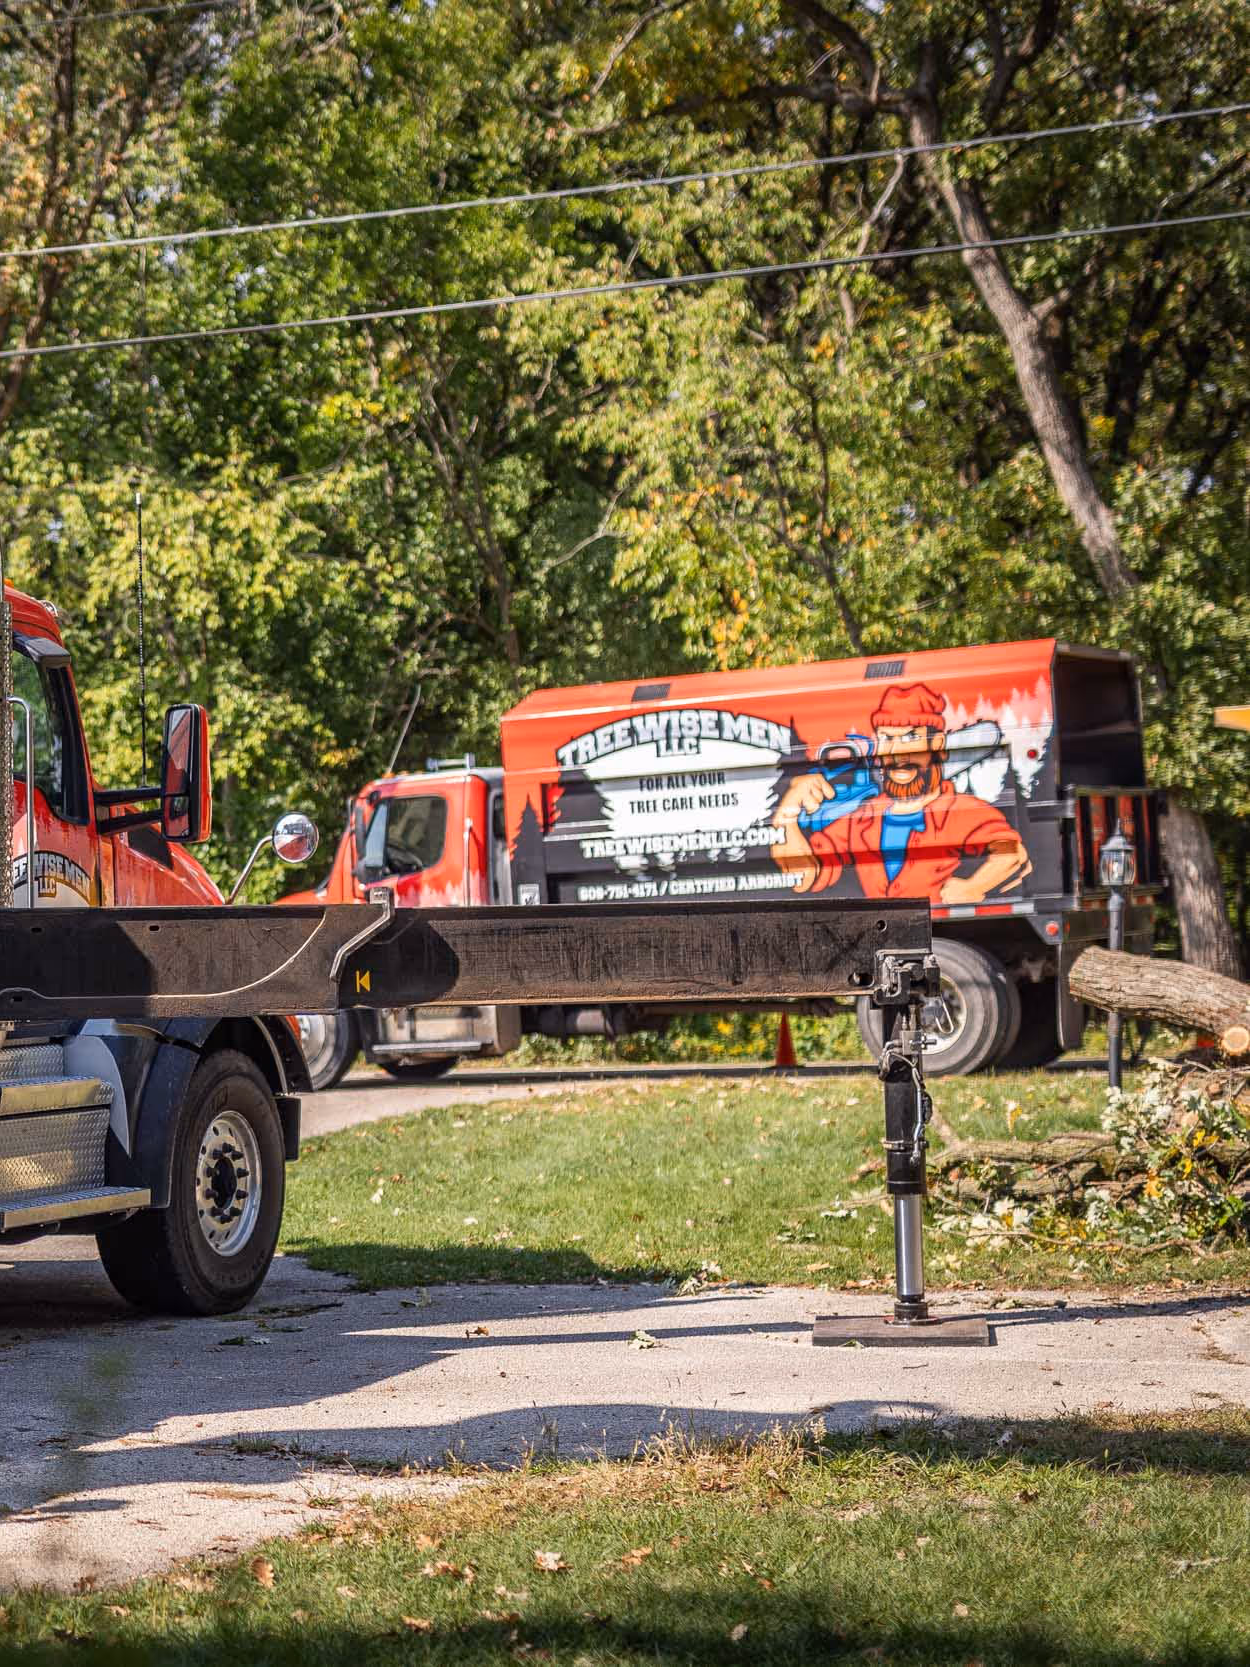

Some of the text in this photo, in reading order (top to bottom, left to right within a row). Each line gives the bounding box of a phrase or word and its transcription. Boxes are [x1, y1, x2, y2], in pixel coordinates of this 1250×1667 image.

[556, 709, 791, 767] TREE WISE MEN
[656, 738, 701, 757] LLC
[639, 772, 726, 791] FOR ALL YOUR
[630, 793, 739, 814] TREE CARE NEEDS
[580, 827, 786, 858] TREEWISEMENLLC.COM
[65, 860, 91, 899] MEN
[669, 876, 735, 895] CERTIFIED
[737, 872, 804, 890] ARBORIST
